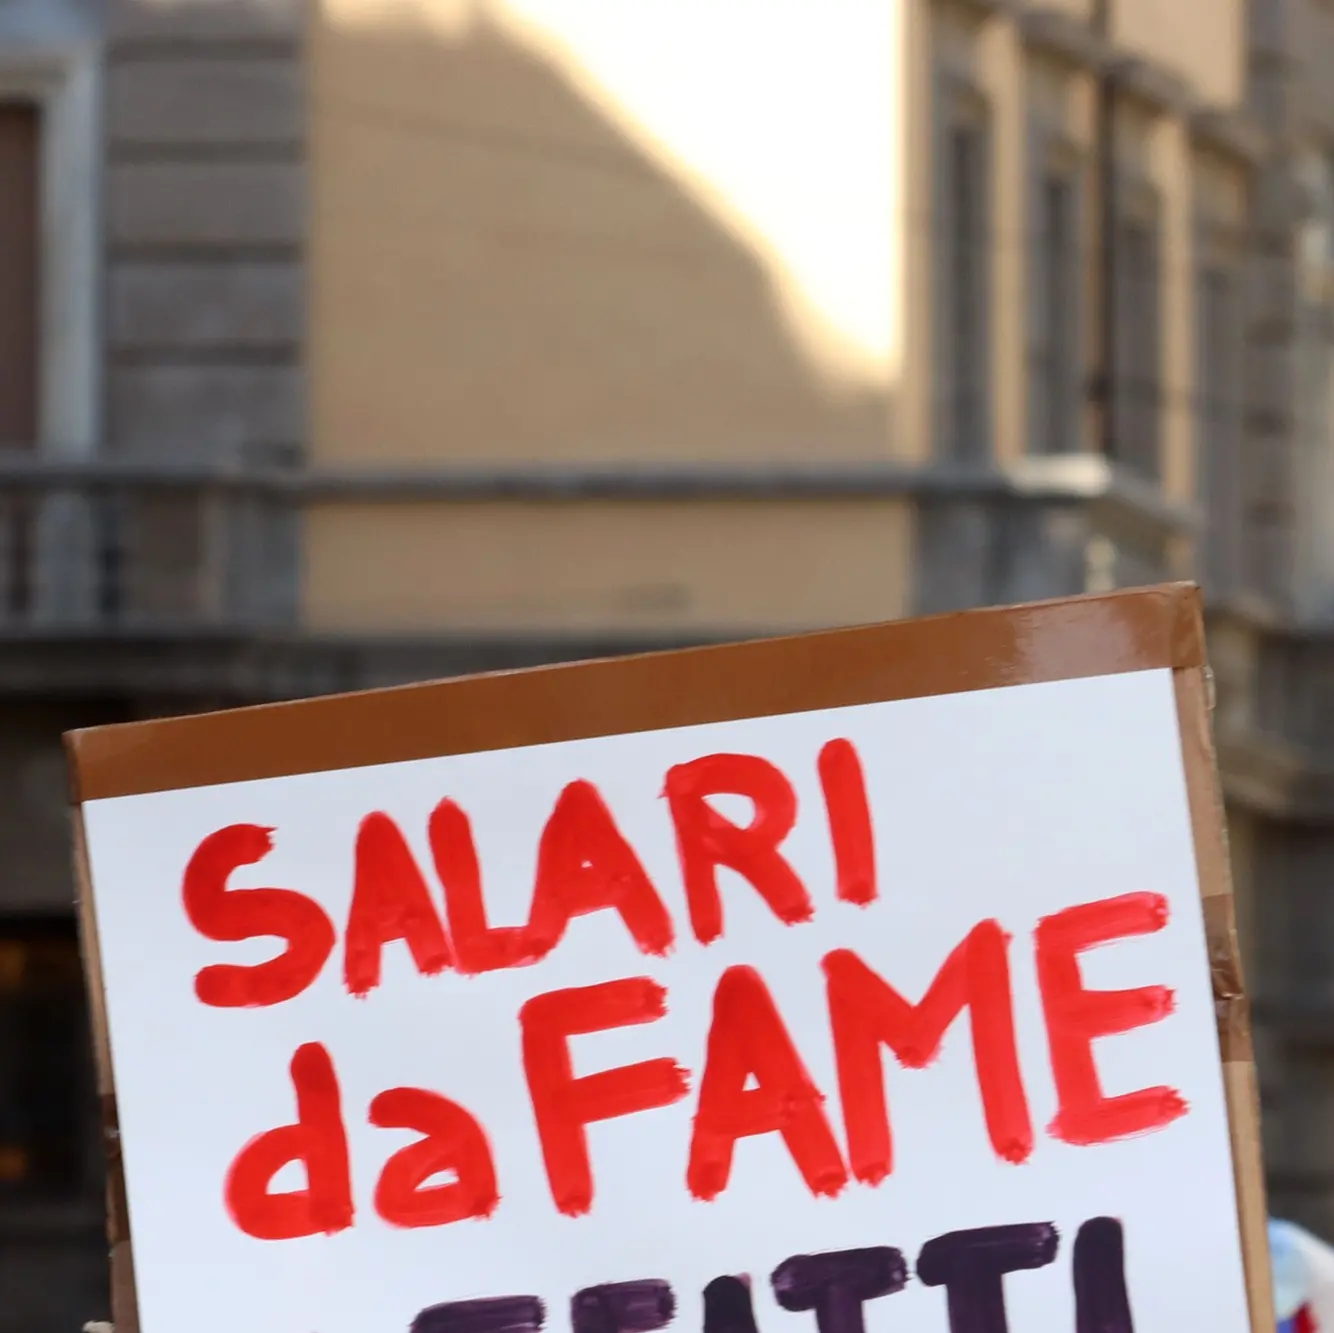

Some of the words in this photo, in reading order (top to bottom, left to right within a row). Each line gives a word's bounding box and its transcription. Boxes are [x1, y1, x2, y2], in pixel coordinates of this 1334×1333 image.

[181, 736, 878, 1009] SALARI
[223, 1040, 502, 1241] da
[517, 890, 1188, 1218] FAME
